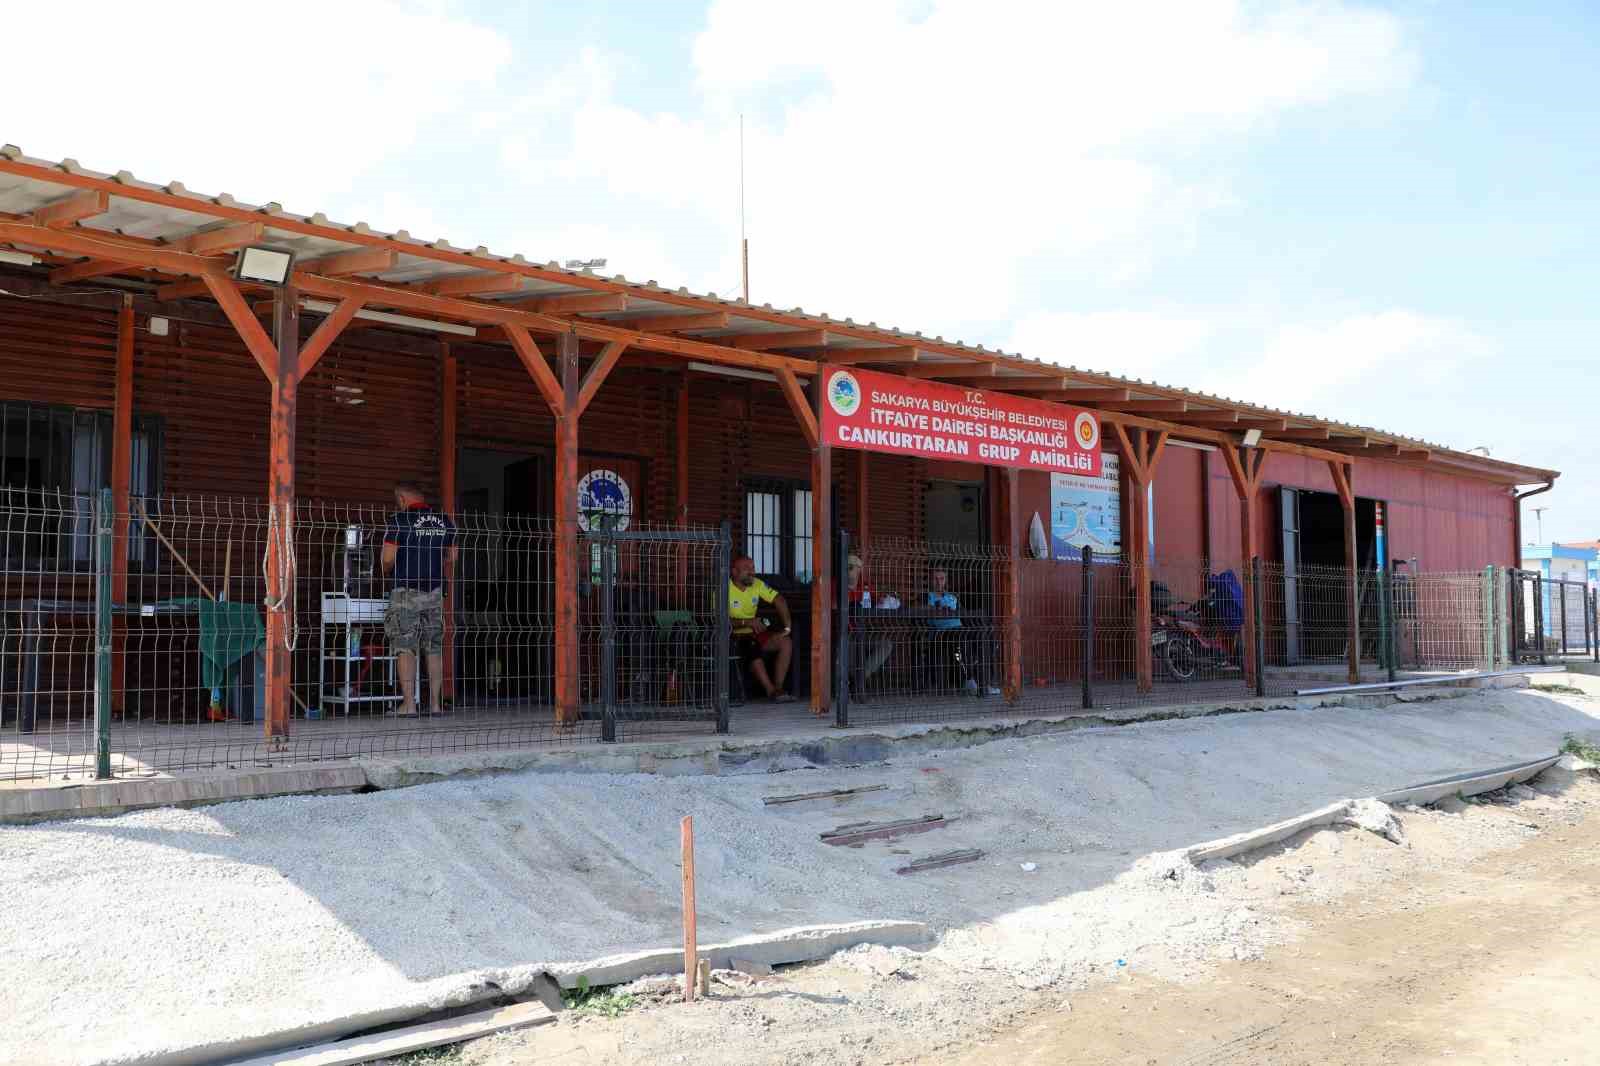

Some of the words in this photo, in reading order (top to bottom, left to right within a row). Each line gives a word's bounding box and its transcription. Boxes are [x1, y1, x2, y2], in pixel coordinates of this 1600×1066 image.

[871, 391, 930, 411] SAKARYA
[932, 400, 1006, 422] BÜYÜKŞEHİR
[1008, 412, 1068, 431] BELEDİYESİ
[965, 391, 986, 404] T.C.
[838, 425, 969, 455] CANKURTARAN
[979, 443, 1020, 461] GRUP
[1030, 449, 1092, 471] AMİRLİĞİ
[870, 407, 929, 430] İTFAİYE
[932, 416, 988, 437] DAİRESİ
[990, 425, 1068, 449] BAŞKANLIĞI
